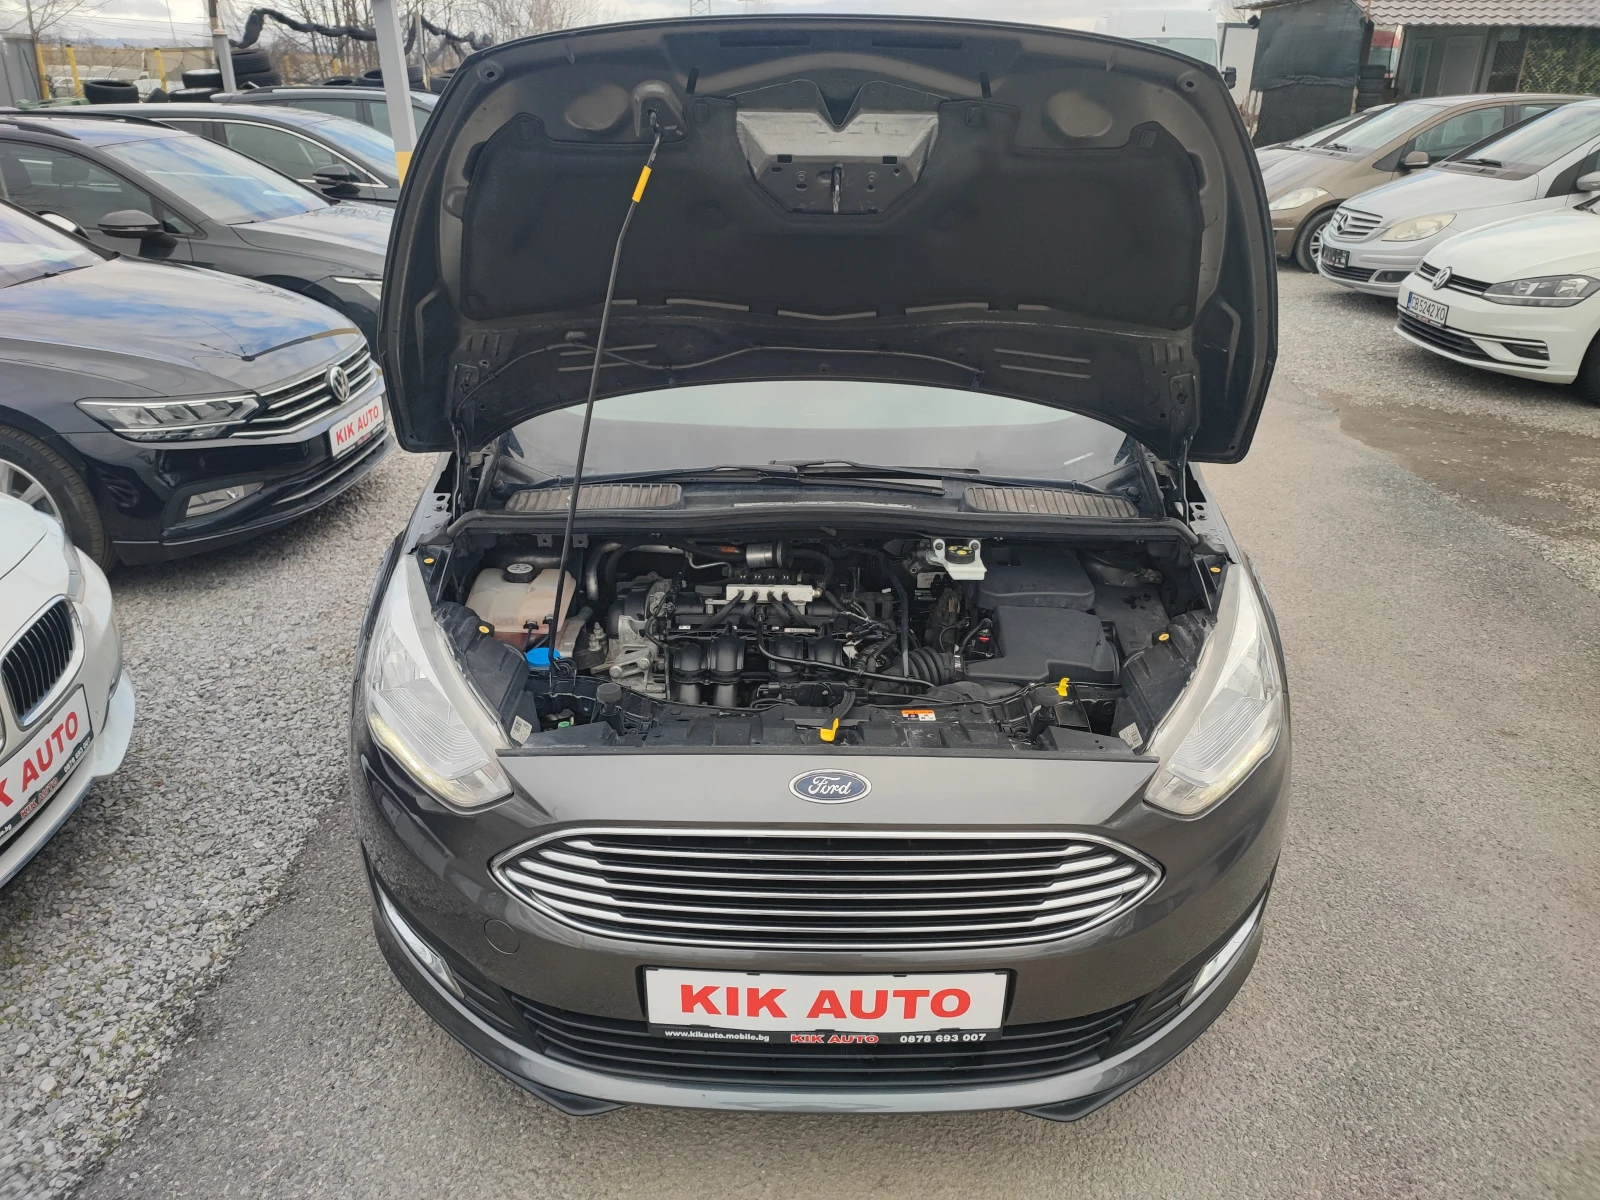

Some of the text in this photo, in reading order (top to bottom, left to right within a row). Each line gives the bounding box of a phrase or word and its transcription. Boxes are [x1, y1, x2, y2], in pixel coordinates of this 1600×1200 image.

[335, 422, 355, 445] KIK
[357, 405, 379, 432] AUTO
[22, 711, 78, 793] AUTO
[807, 776, 852, 795] Ford
[680, 984, 972, 1020] KIK AUTO
[665, 1030, 770, 1042] www.kikauto.mobile.bg
[790, 1034, 880, 1044] KIK AUTO
[900, 1033, 987, 1043] 0878 693 007
